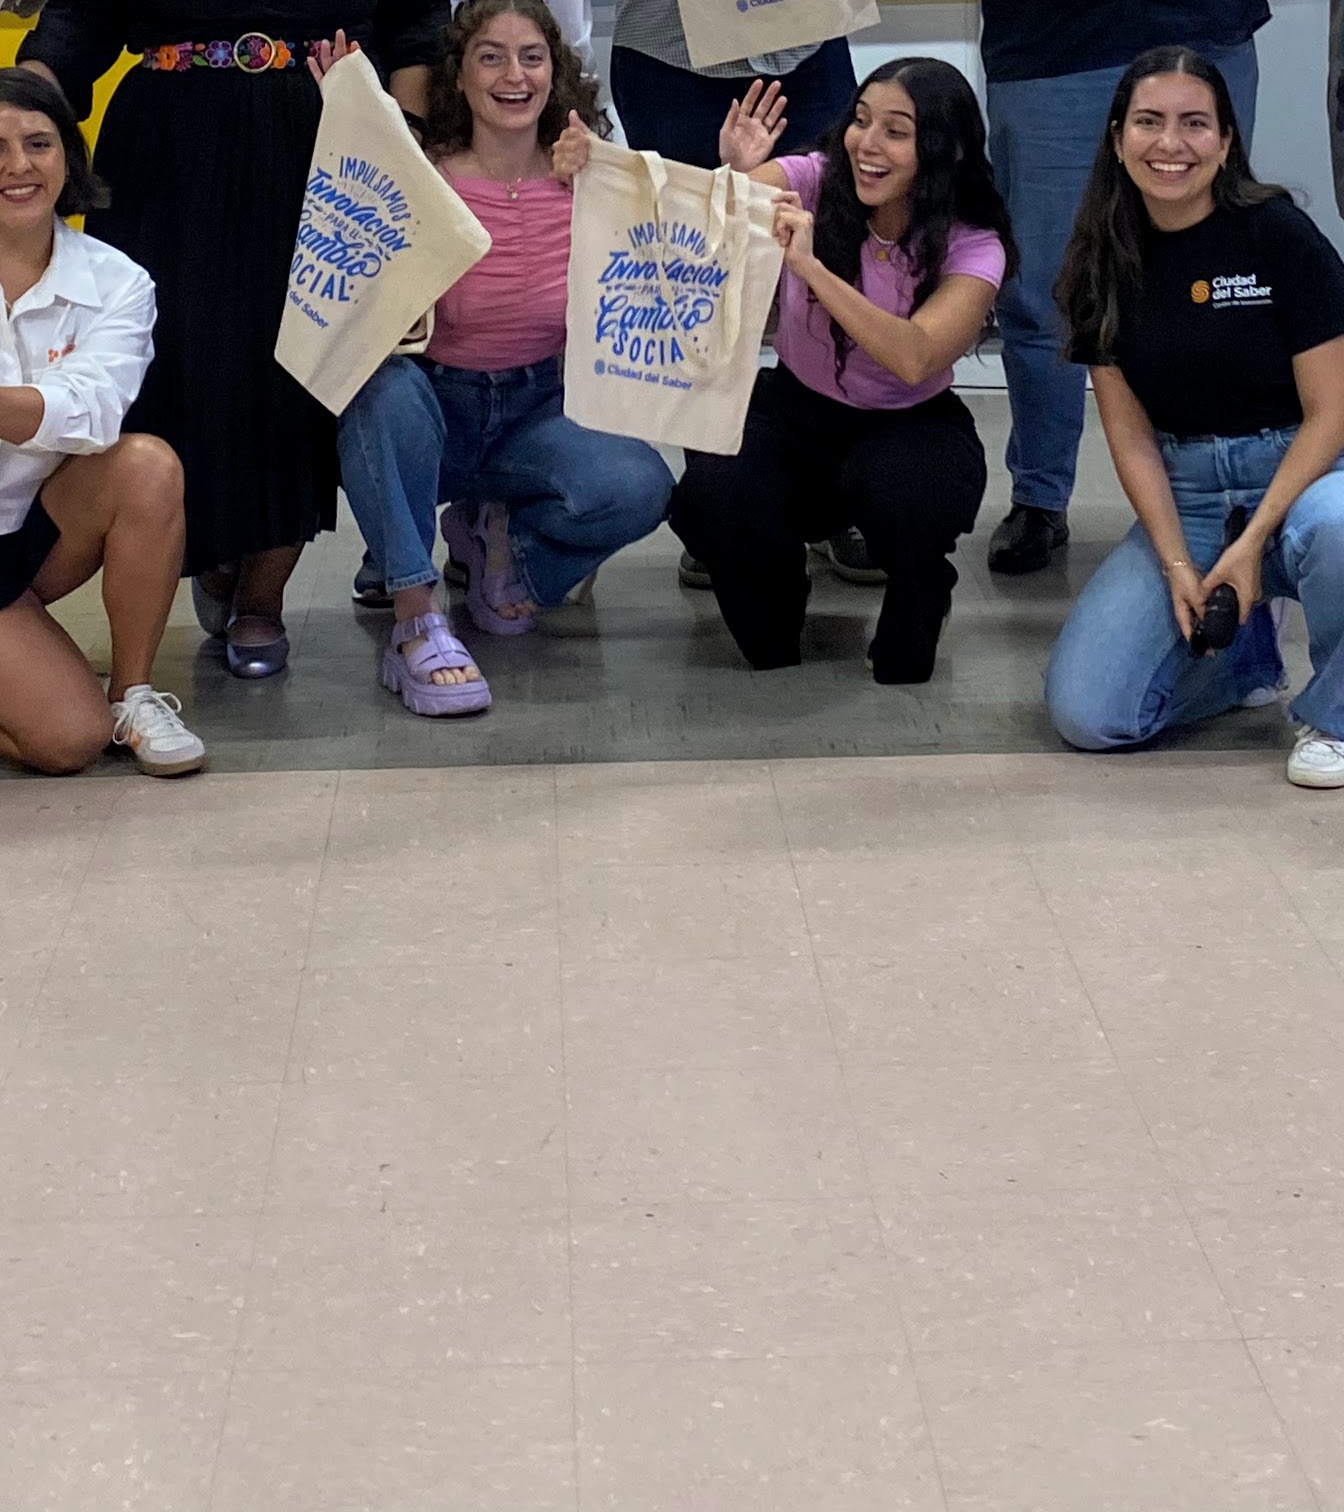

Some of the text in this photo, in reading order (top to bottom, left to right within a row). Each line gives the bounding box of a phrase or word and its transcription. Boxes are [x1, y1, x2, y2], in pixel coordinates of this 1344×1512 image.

[339, 155, 412, 223] IMPULSAMOS
[291, 253, 350, 301] OCIAL
[1212, 273, 1257, 288] Ciudad
[1212, 285, 1272, 300] del Saber
[289, 292, 328, 327] del Saber
[613, 329, 685, 365] SOCIA
[608, 364, 692, 390] Ciudad del Saber
